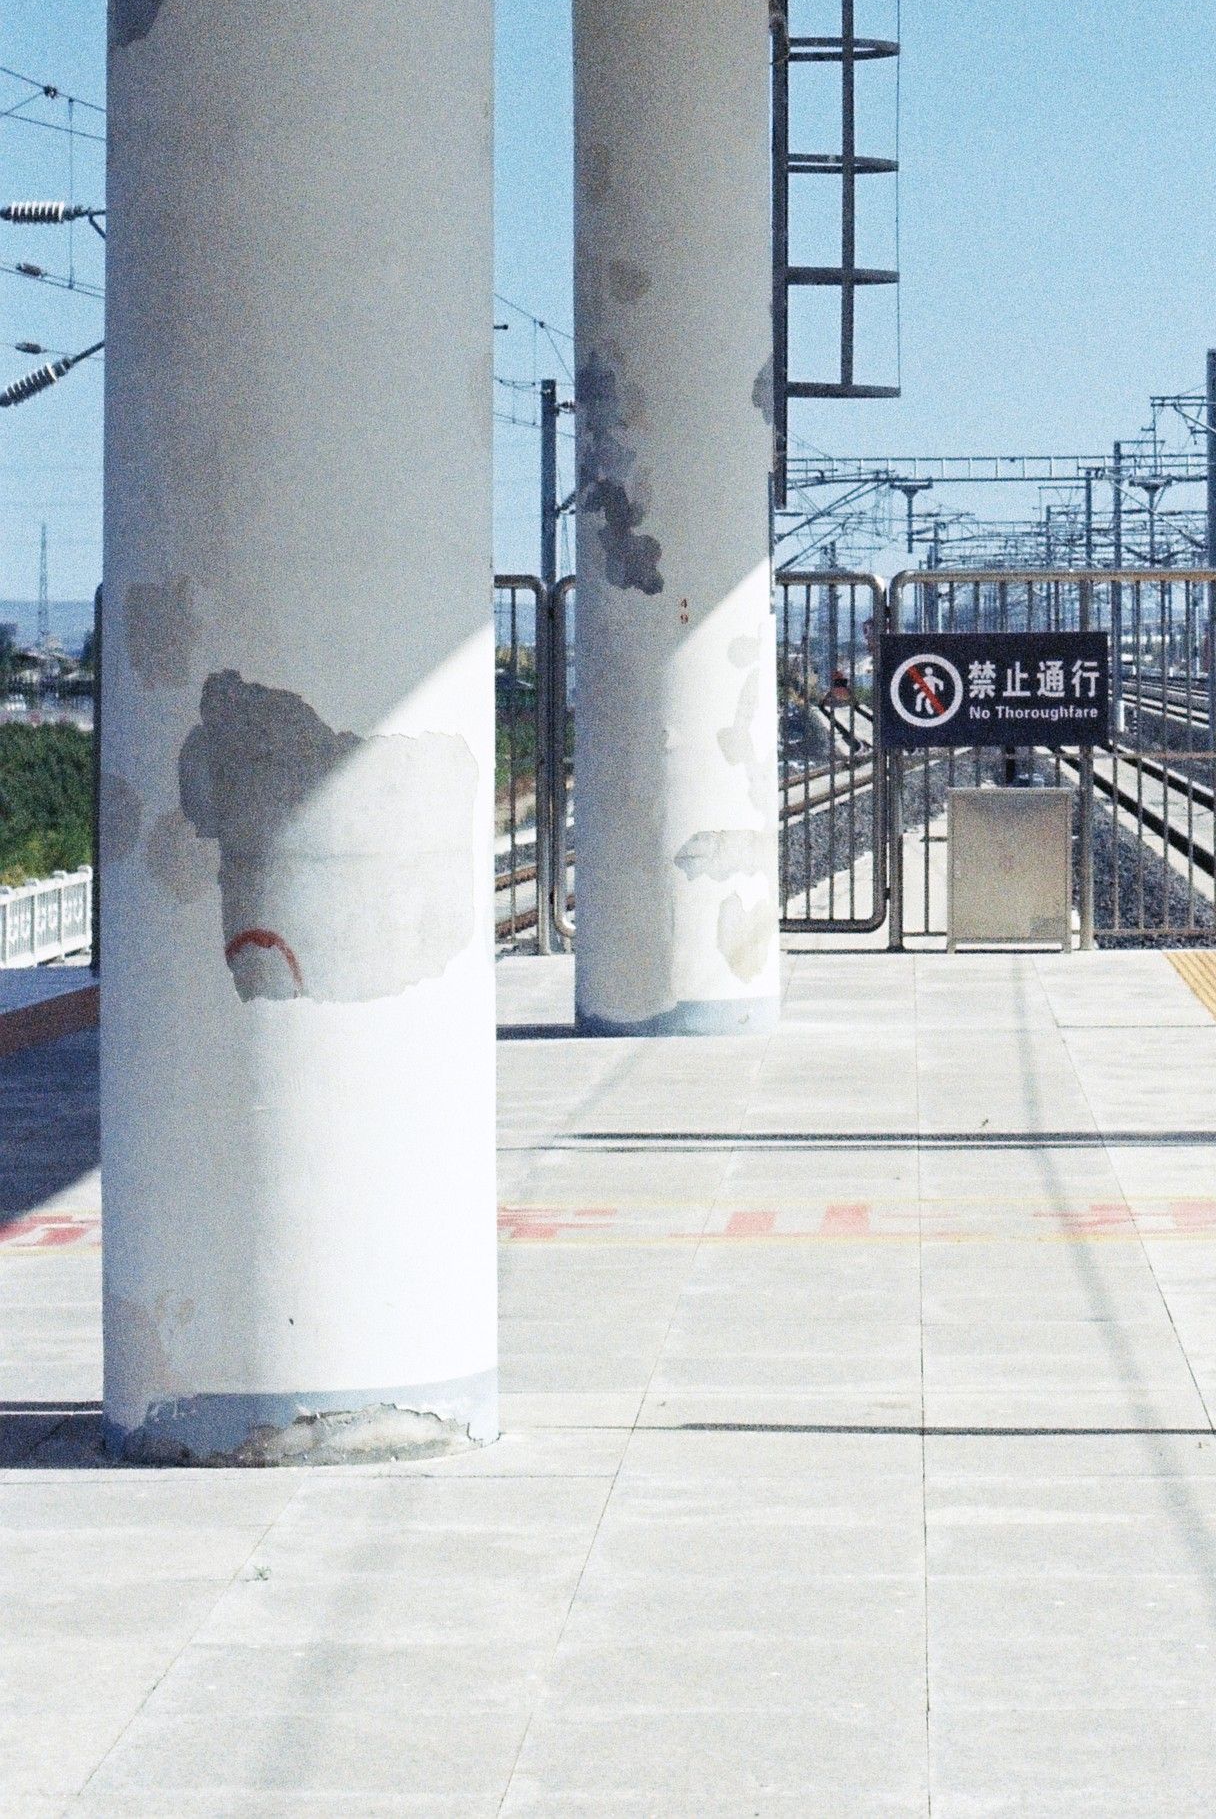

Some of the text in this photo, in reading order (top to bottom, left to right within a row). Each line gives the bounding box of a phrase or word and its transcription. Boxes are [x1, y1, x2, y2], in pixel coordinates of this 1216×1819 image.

[968, 659, 1100, 700] 禁止通行
[968, 705, 1099, 722] No Thoroughfare
